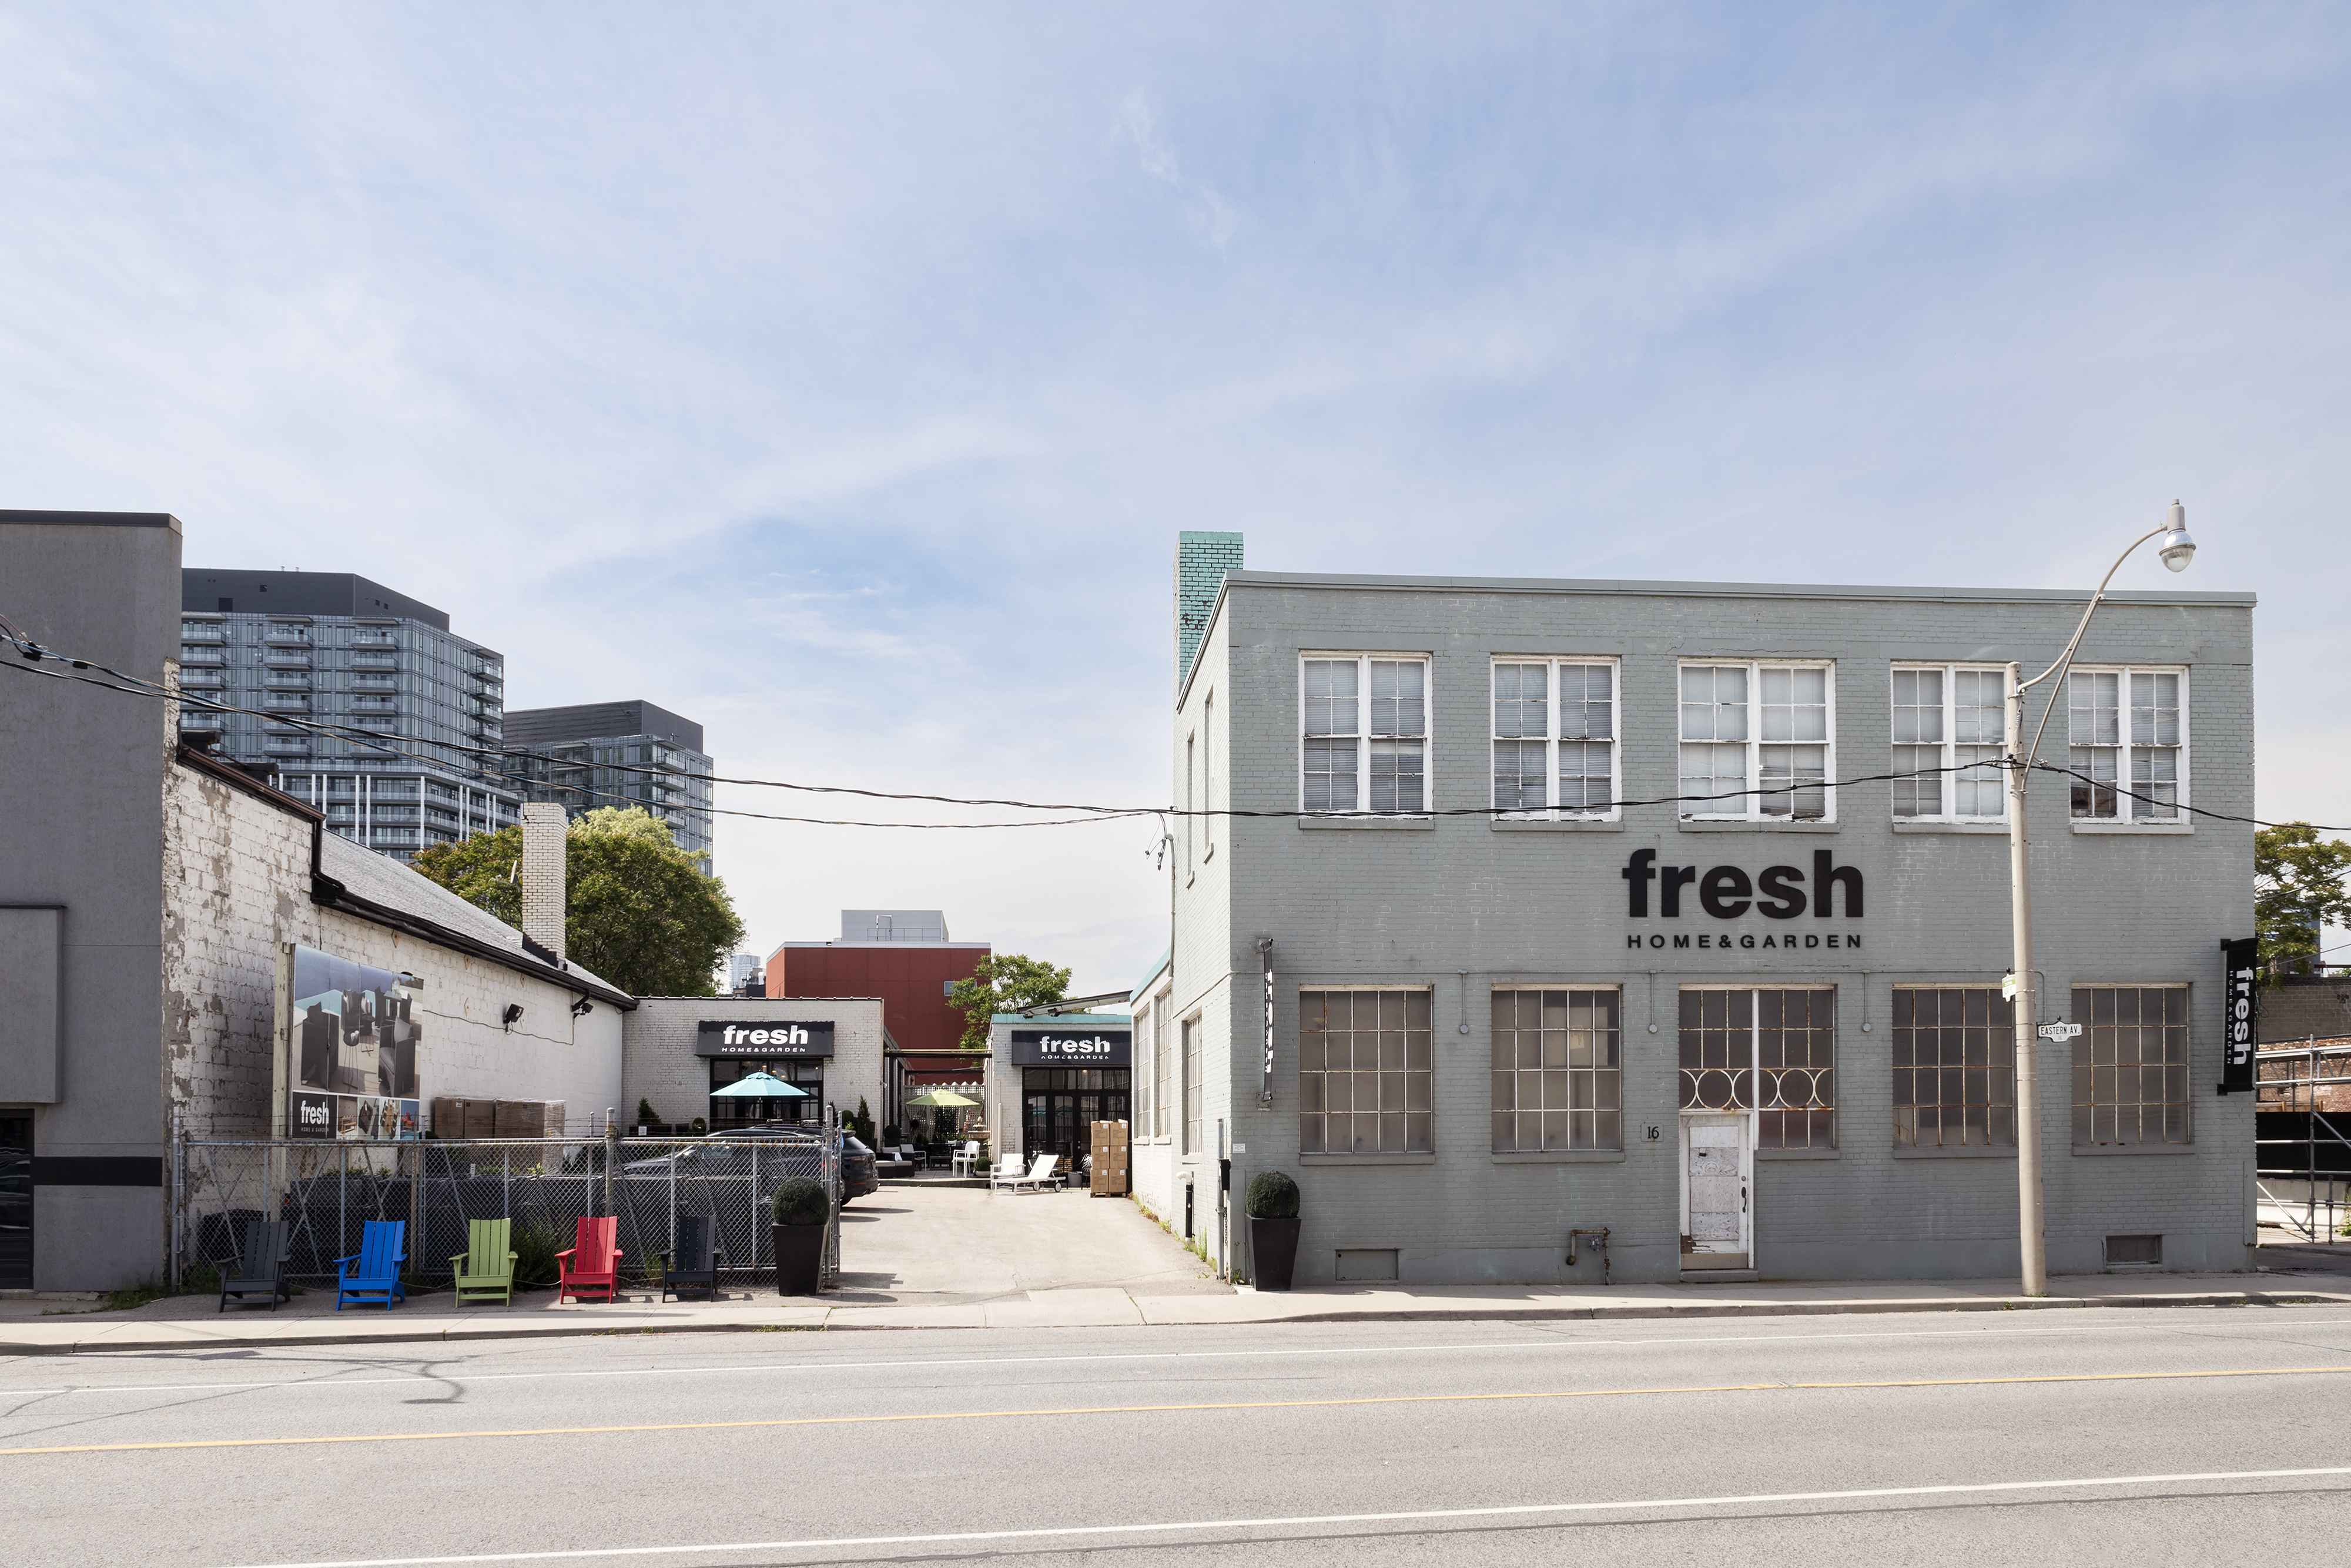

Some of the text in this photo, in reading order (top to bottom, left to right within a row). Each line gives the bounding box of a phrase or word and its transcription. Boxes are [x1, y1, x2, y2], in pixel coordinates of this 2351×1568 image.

[1622, 849, 1863, 919] fresh
[1627, 934, 1861, 949] HOME&GARDEN
[2233, 967, 2255, 1065] fresh
[723, 1025, 809, 1045] fresh
[2041, 1026, 2079, 1035] EASTERN AV.
[1039, 1036, 1110, 1053] fresh
[300, 1100, 329, 1125] fresh
[1647, 1127, 1659, 1140] 16
